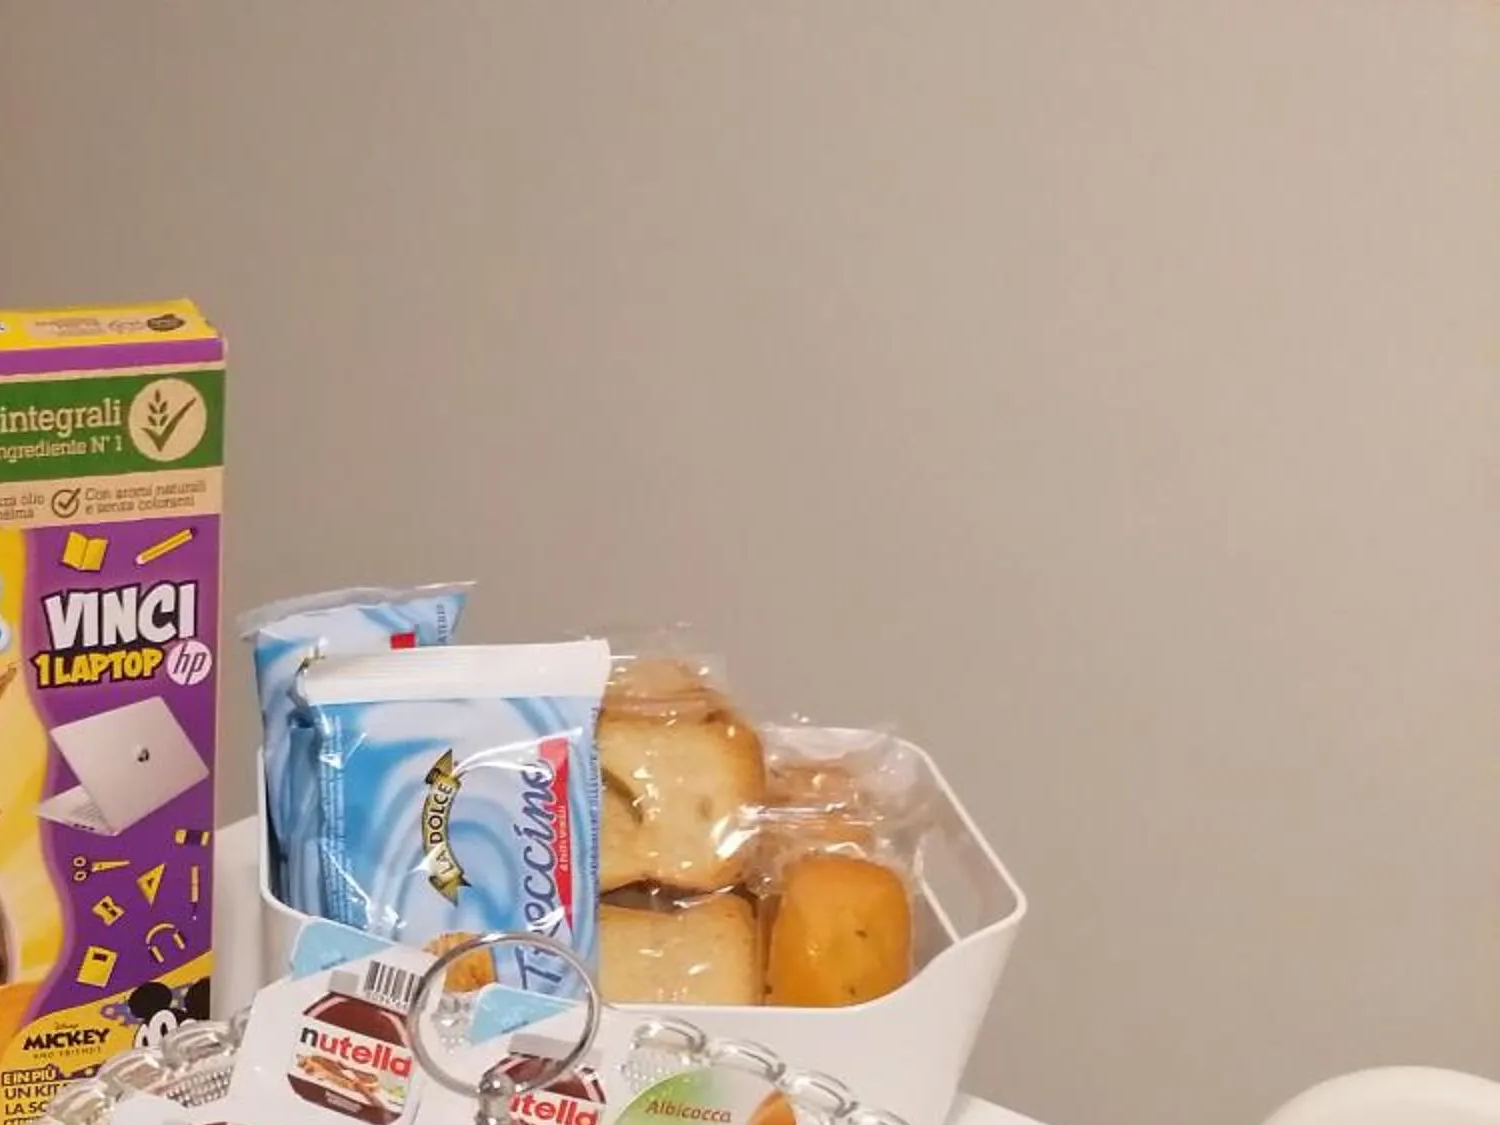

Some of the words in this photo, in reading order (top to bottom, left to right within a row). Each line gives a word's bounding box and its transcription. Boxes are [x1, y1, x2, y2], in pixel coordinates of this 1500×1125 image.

[0, 398, 121, 438] integrali
[115, 435, 122, 450] 1
[21, 495, 46, 507] olio
[45, 582, 197, 650] VINCI
[54, 647, 163, 685] LAPTOP
[173, 641, 207, 685] hp
[428, 780, 453, 846] DOLCE
[23, 1027, 110, 1052] MICKEY
[300, 1024, 413, 1079] nutella
[4, 1086, 30, 1100] UN
[5, 1102, 27, 1116] LA
[645, 1099, 732, 1124] Albicocca
